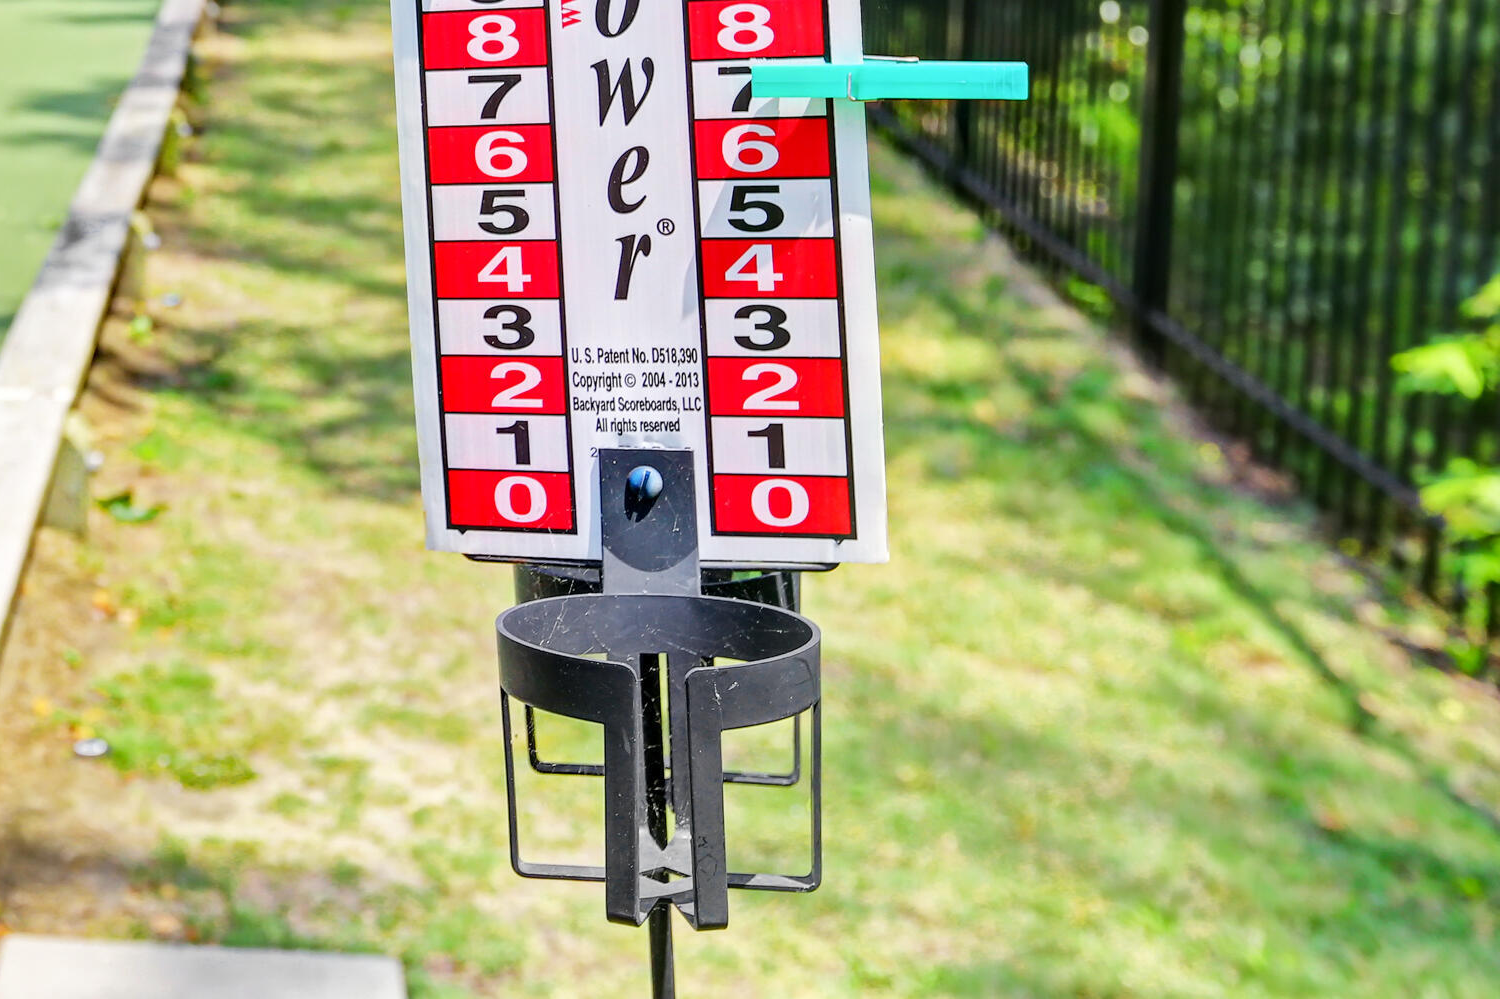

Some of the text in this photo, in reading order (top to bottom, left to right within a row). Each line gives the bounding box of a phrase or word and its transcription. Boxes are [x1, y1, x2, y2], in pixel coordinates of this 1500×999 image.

[466, 14, 520, 62] 8
[717, 3, 775, 53] 8
[467, 73, 522, 120] 7
[717, 65, 754, 113] 7
[474, 130, 528, 178] 6
[721, 124, 779, 173] 6
[477, 189, 530, 235] 5
[727, 184, 785, 233] 5
[477, 246, 532, 293] 4
[724, 244, 784, 292] 4
[483, 304, 535, 351] 3
[733, 304, 791, 352] 3
[571, 347, 698, 367] U. S. Patent No. D518,390
[490, 361, 544, 408] 2
[572, 372, 622, 392] Copyright
[624, 373, 636, 388] ©
[642, 372, 666, 388] 2004
[675, 372, 699, 388] 2013
[741, 362, 800, 411] 2
[573, 397, 702, 415] Backyard Scoreboards, LLC
[596, 418, 680, 436] All rights reserved
[496, 420, 531, 466] 1
[747, 423, 786, 469] 1
[494, 475, 547, 523] 0
[751, 478, 810, 527] 0
